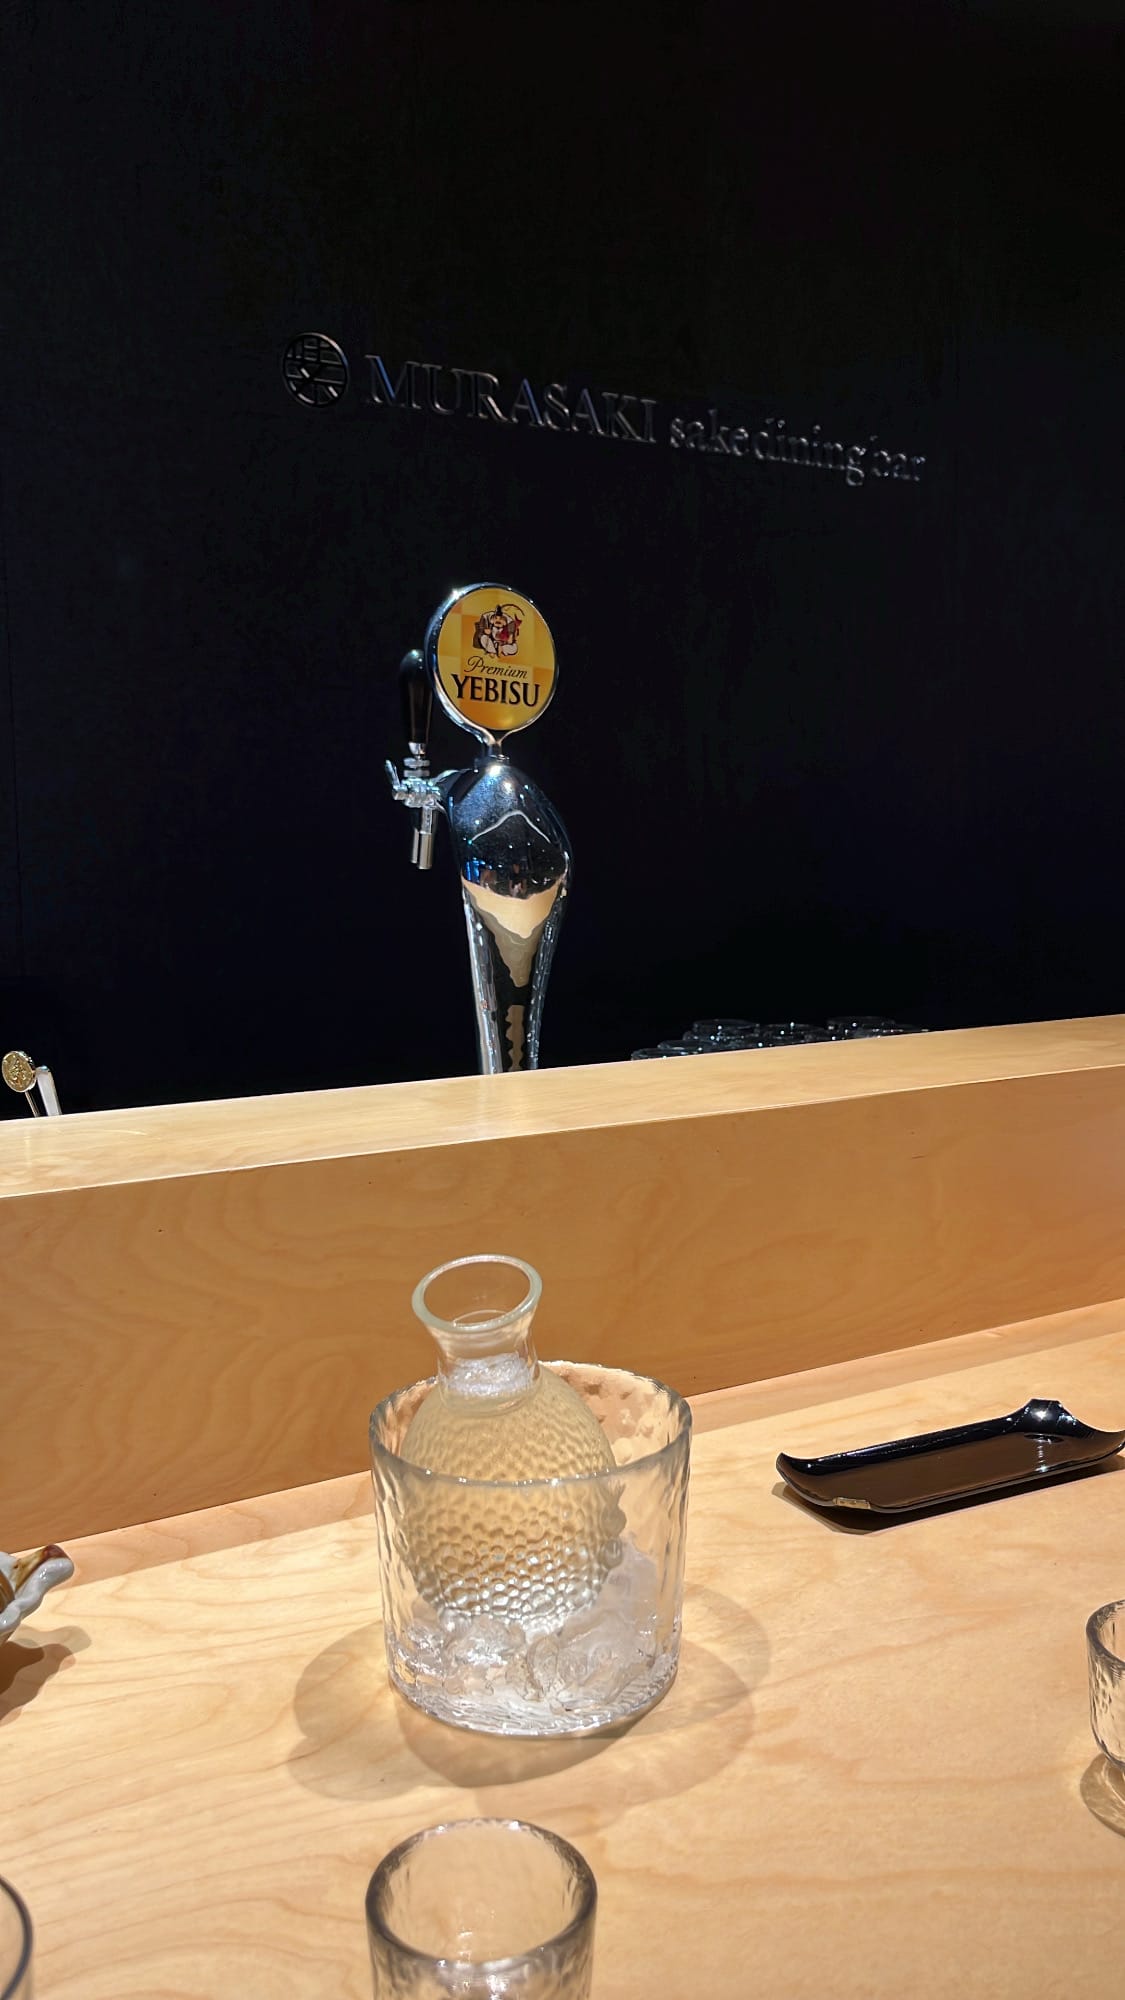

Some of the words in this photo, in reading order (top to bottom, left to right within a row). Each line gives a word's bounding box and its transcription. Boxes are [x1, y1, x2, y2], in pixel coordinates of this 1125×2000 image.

[365, 354, 657, 444] MURASAKI
[669, 409, 750, 456] sake
[753, 417, 867, 487] dining
[868, 435, 927, 482] bar
[463, 655, 528, 679] Premium
[450, 674, 541, 708] YEBISU
